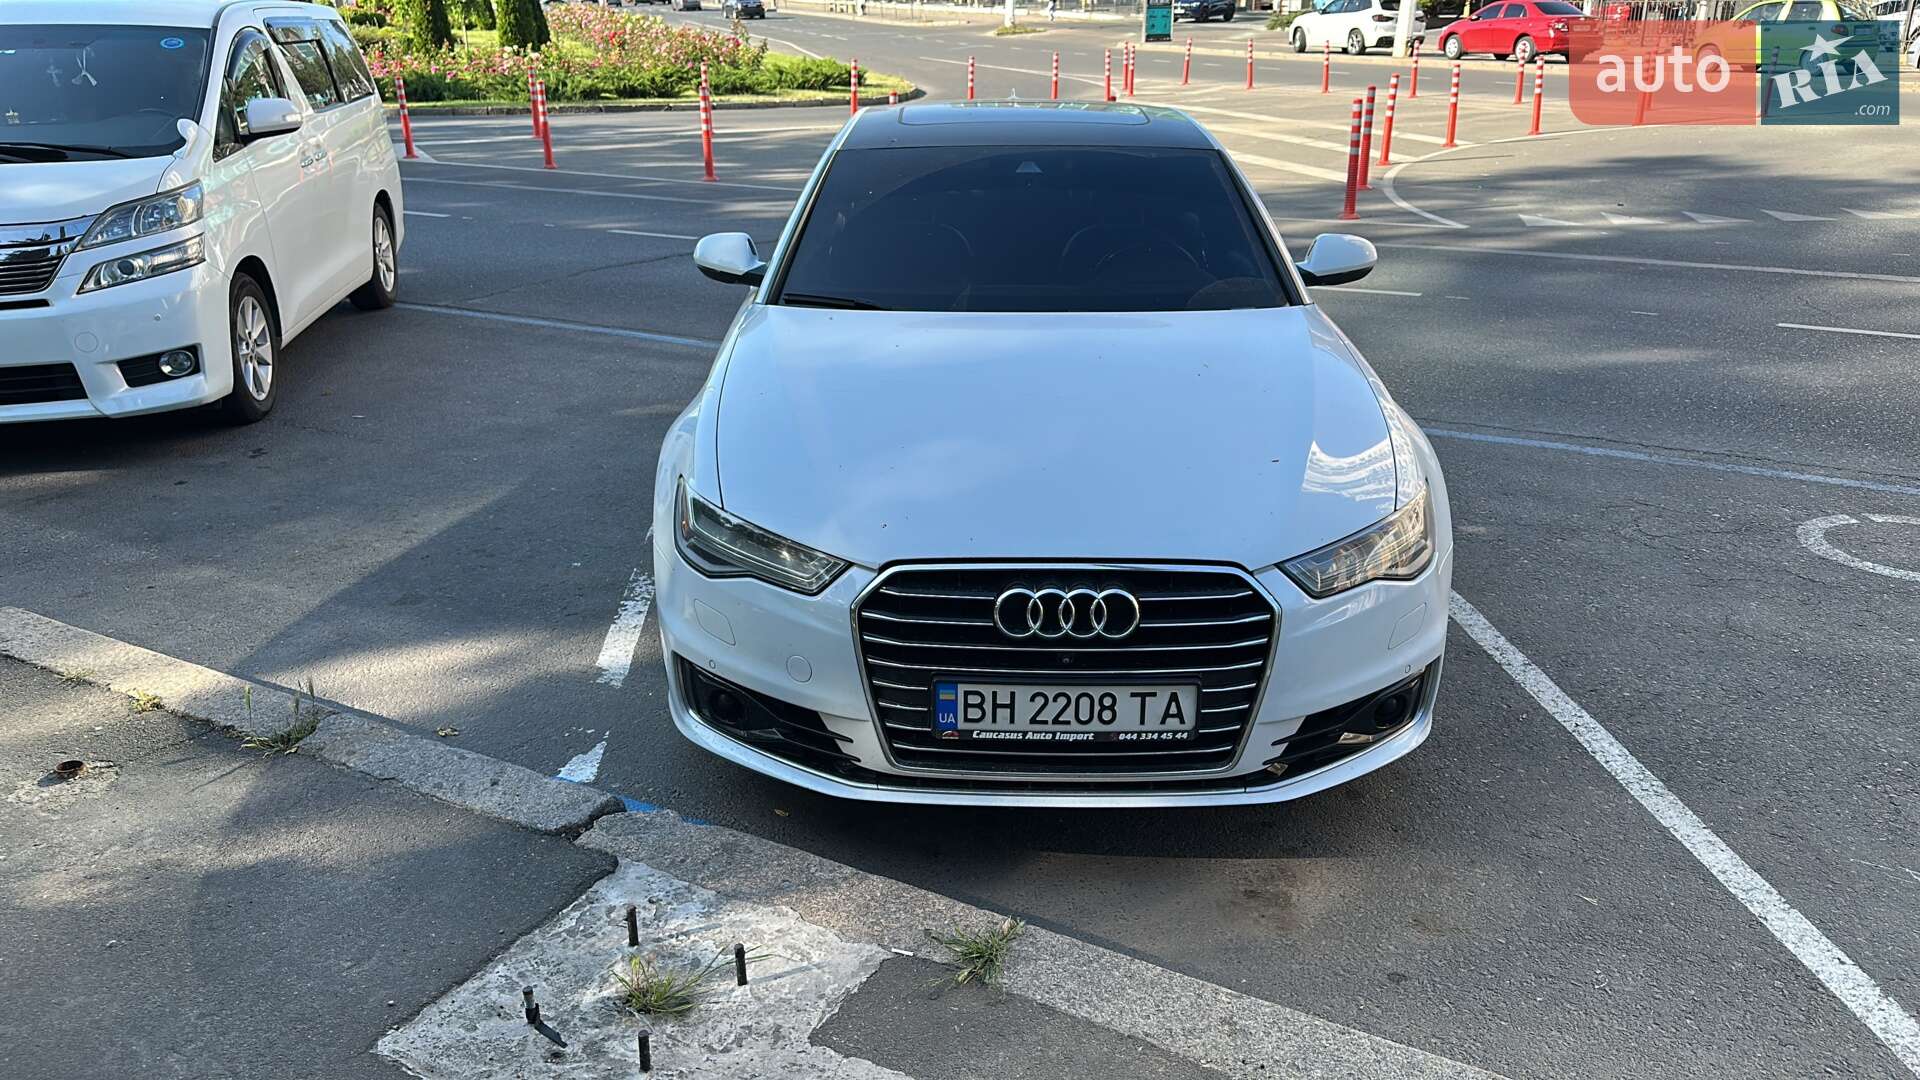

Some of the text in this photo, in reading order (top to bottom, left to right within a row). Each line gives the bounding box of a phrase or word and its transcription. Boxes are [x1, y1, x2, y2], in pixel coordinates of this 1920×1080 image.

[963, 690, 1186, 725] BH 2208 TA
[939, 713, 956, 723] UA
[972, 730, 1188, 742] Caucasus Auto Import 044 334 45 44
